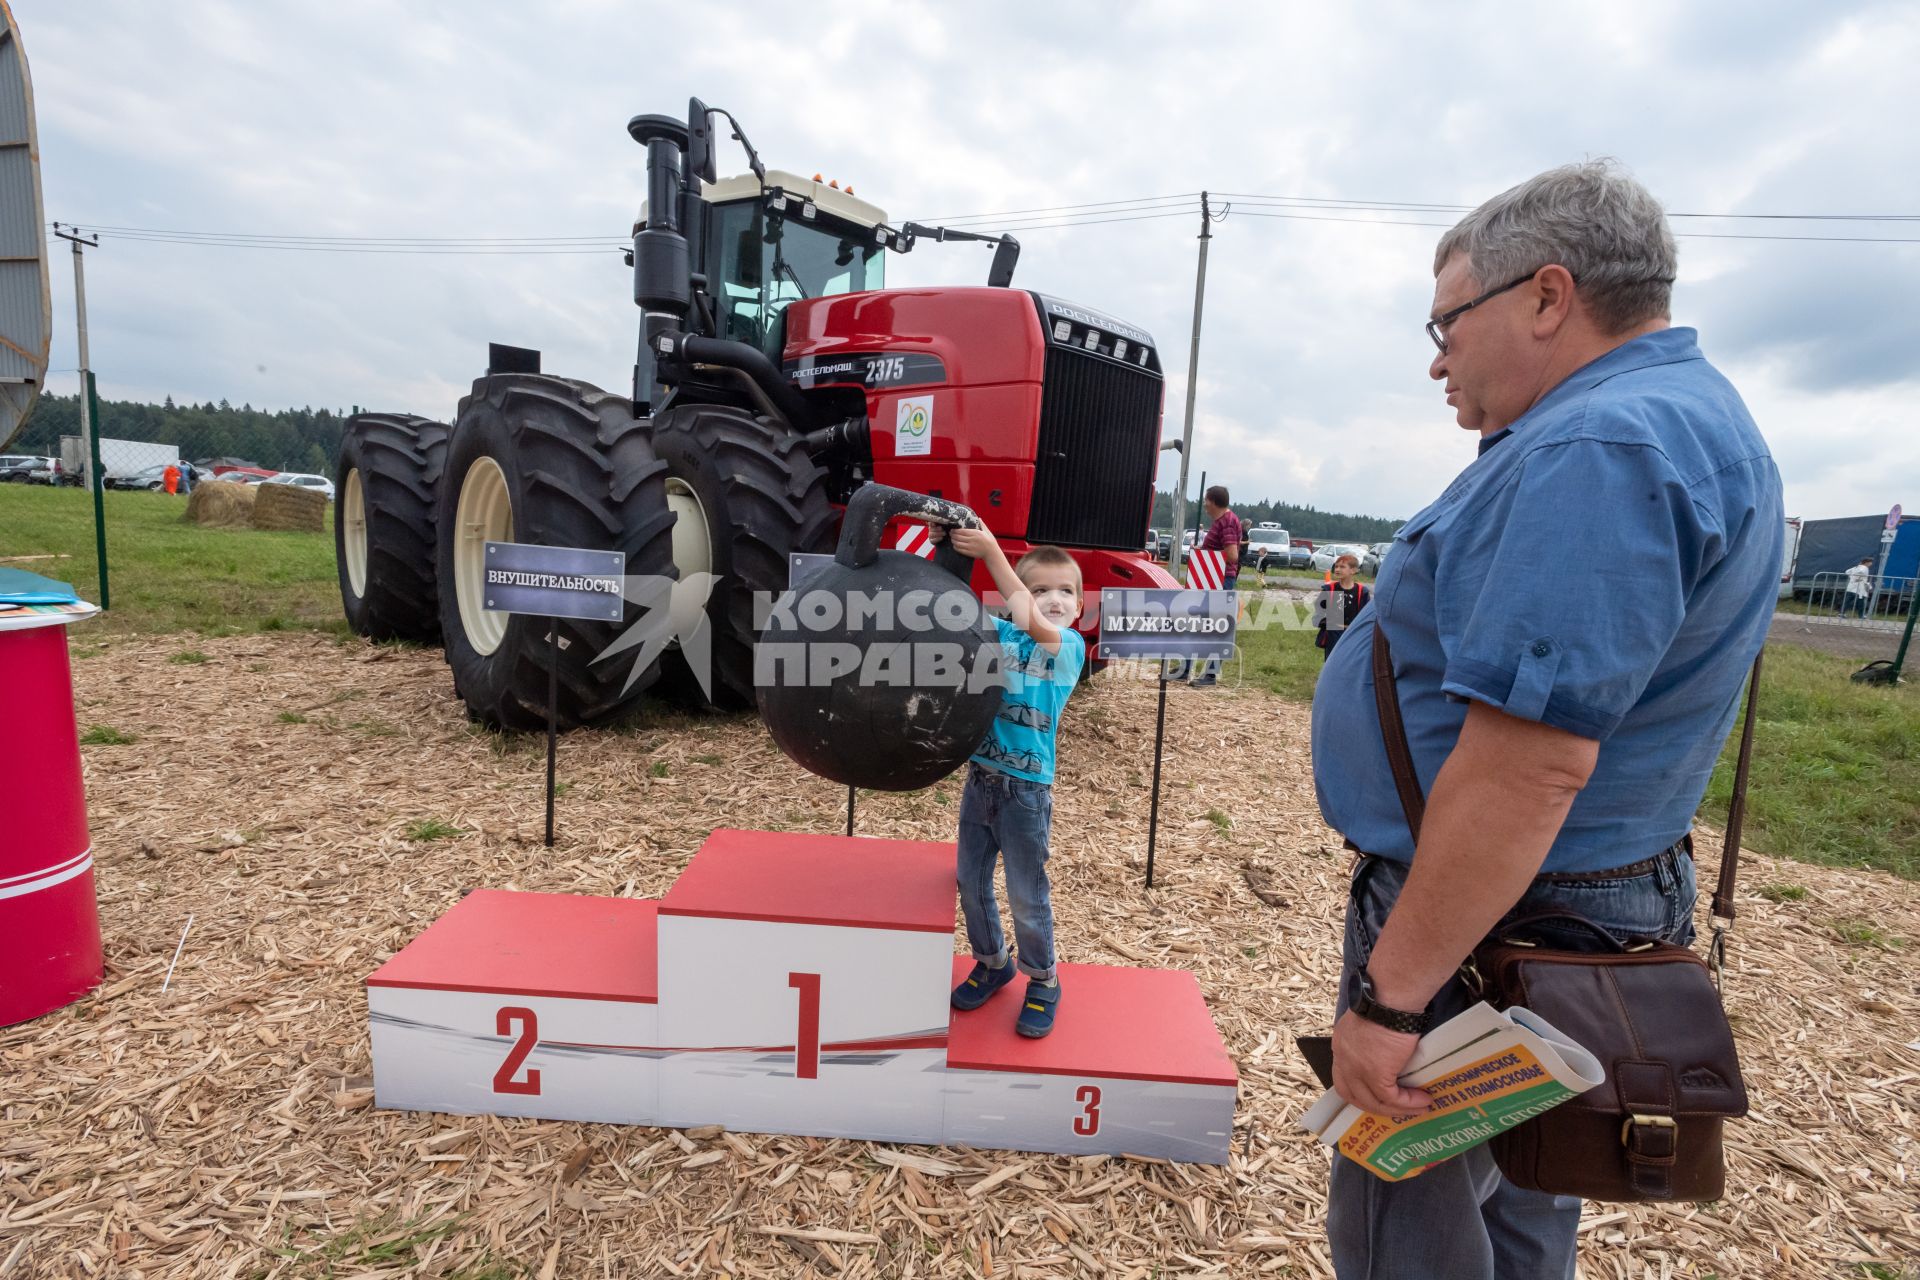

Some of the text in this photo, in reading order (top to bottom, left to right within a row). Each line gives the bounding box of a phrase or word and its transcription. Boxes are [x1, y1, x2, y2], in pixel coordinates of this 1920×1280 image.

[792, 362, 852, 379] РОСТСЕЛЬМАШ
[865, 357, 905, 383] 2375
[899, 402, 928, 437] 20
[487, 570, 620, 594] ВНУШИТЕЛЬНОСТЬ
[1107, 615, 1229, 634] МУЖЕСТВО
[788, 972, 822, 1080] 1
[492, 1005, 542, 1096] 2
[1424, 1052, 1522, 1096] СТРОНОМИЧЕСКОЕ
[1458, 1091, 1467, 1102] В
[1467, 1063, 1545, 1098] ПОДМОСКОВЬЕ
[1073, 1084, 1102, 1137] 3
[1355, 1124, 1391, 1157] АВГУСТА
